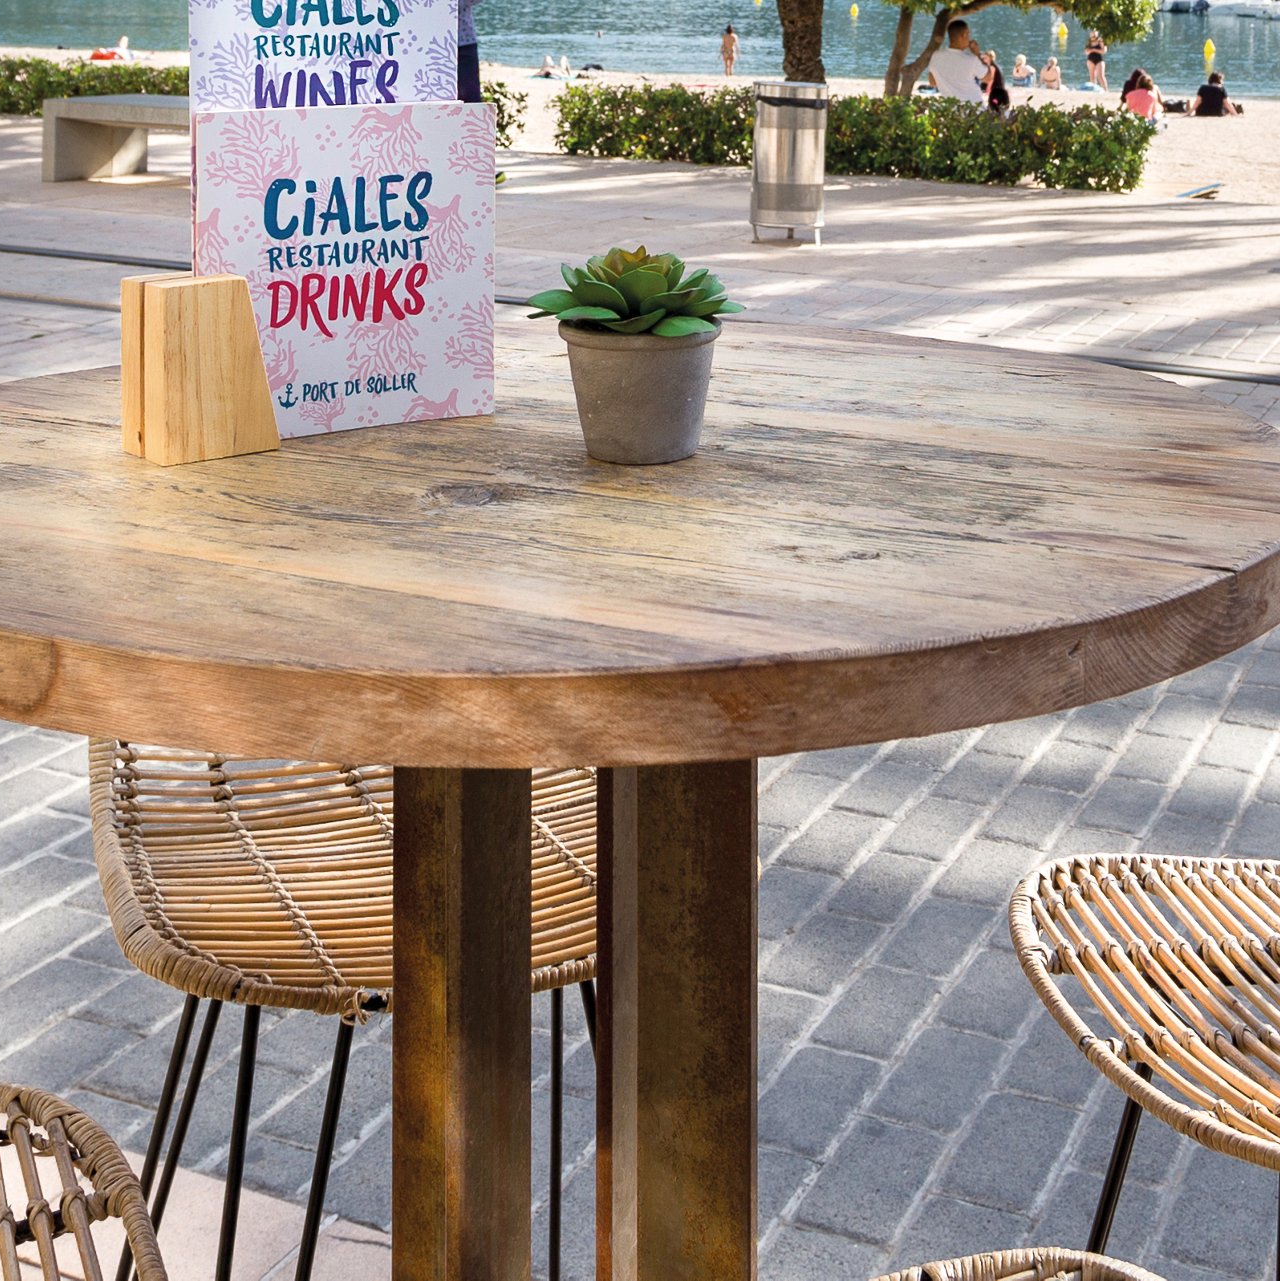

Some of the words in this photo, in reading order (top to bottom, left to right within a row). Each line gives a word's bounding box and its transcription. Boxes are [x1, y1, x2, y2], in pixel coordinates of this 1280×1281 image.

[253, 32, 401, 61] RESTAURANT
[266, 236, 430, 273] RESTAURANT
[267, 262, 429, 339] DRINKS
[302, 381, 339, 404] PORT
[344, 378, 362, 397] DE
